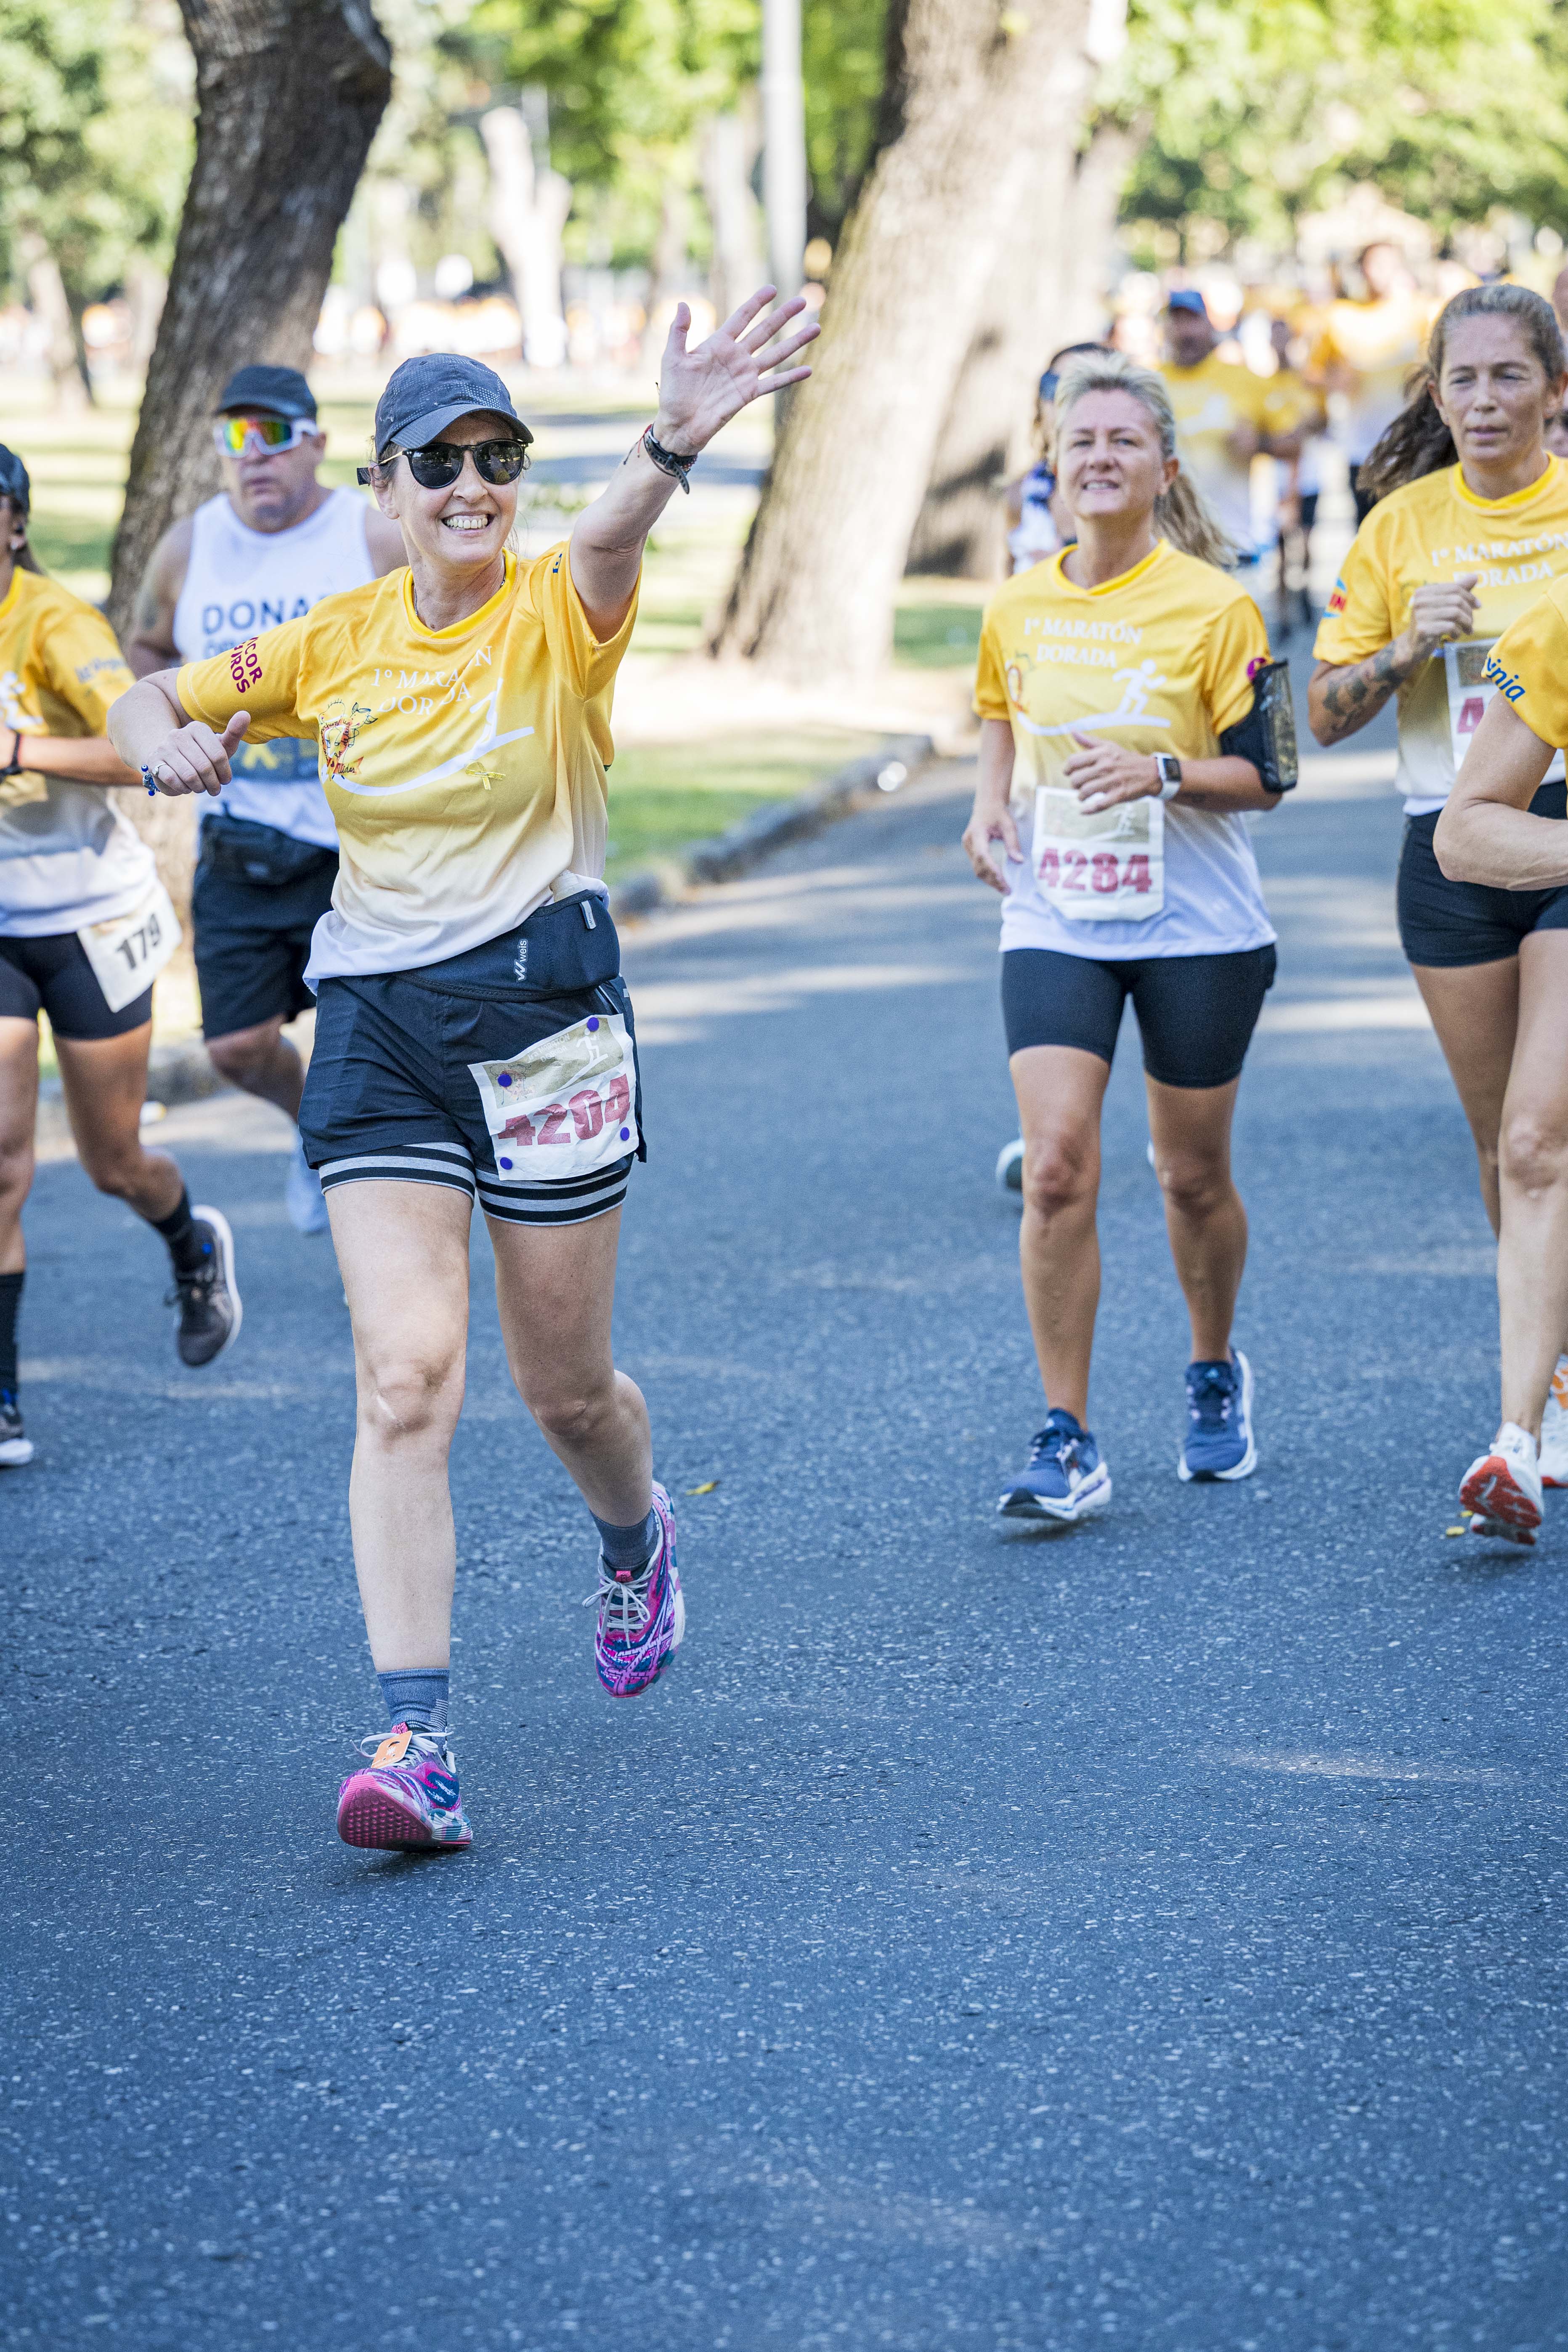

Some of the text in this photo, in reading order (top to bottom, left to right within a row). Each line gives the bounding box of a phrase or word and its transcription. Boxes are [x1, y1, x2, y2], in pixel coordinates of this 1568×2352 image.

[202, 595, 324, 635] DONA
[1042, 617, 1143, 645] MARATÓN
[396, 646, 493, 689] MARAN
[1036, 643, 1118, 668] DORADA
[377, 682, 472, 715] DORDA
[1038, 847, 1152, 893] 4284
[498, 1073, 631, 1147] 4204
